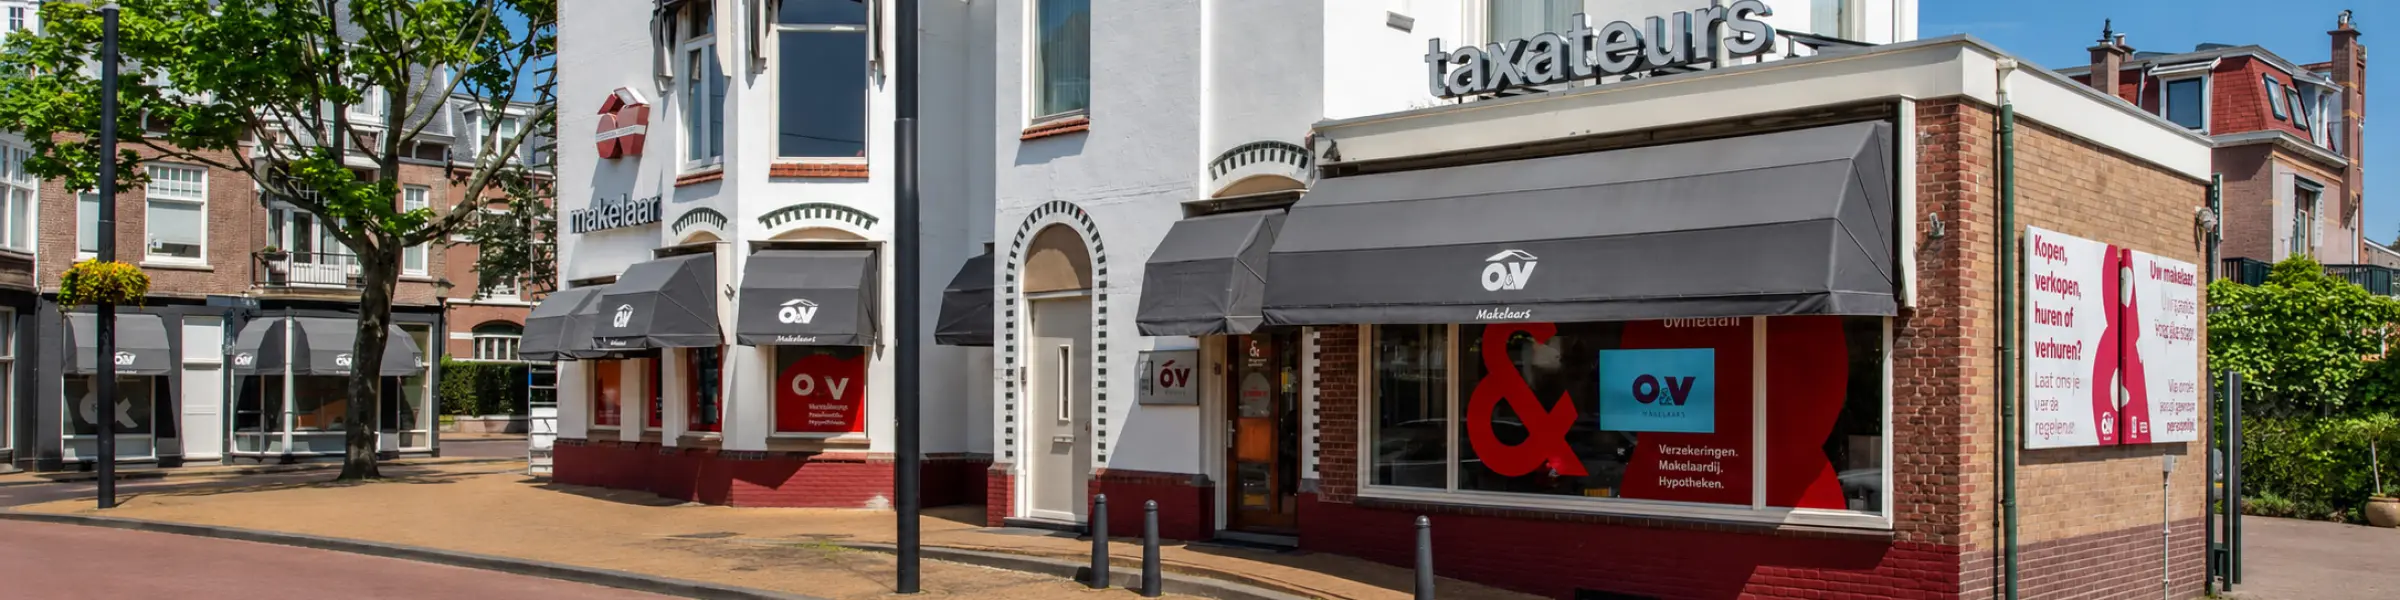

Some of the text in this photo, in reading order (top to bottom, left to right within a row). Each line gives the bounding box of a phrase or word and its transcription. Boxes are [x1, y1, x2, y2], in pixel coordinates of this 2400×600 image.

[1425, 0, 1774, 97] taxateurs
[2034, 234, 2068, 266] Kopen,
[2034, 271, 2082, 300] verkopen,
[1475, 307, 1531, 320] Makelaars
[2035, 301, 2073, 328] huren of
[2035, 337, 2082, 361] verhuren?
[1632, 374, 1696, 406] O&V
[2034, 372, 2053, 389] Laat
[1659, 444, 1739, 459] Verzekeringen.
[1659, 460, 1724, 475] Makelaardij.
[1659, 476, 1725, 489] Hypotheken.
